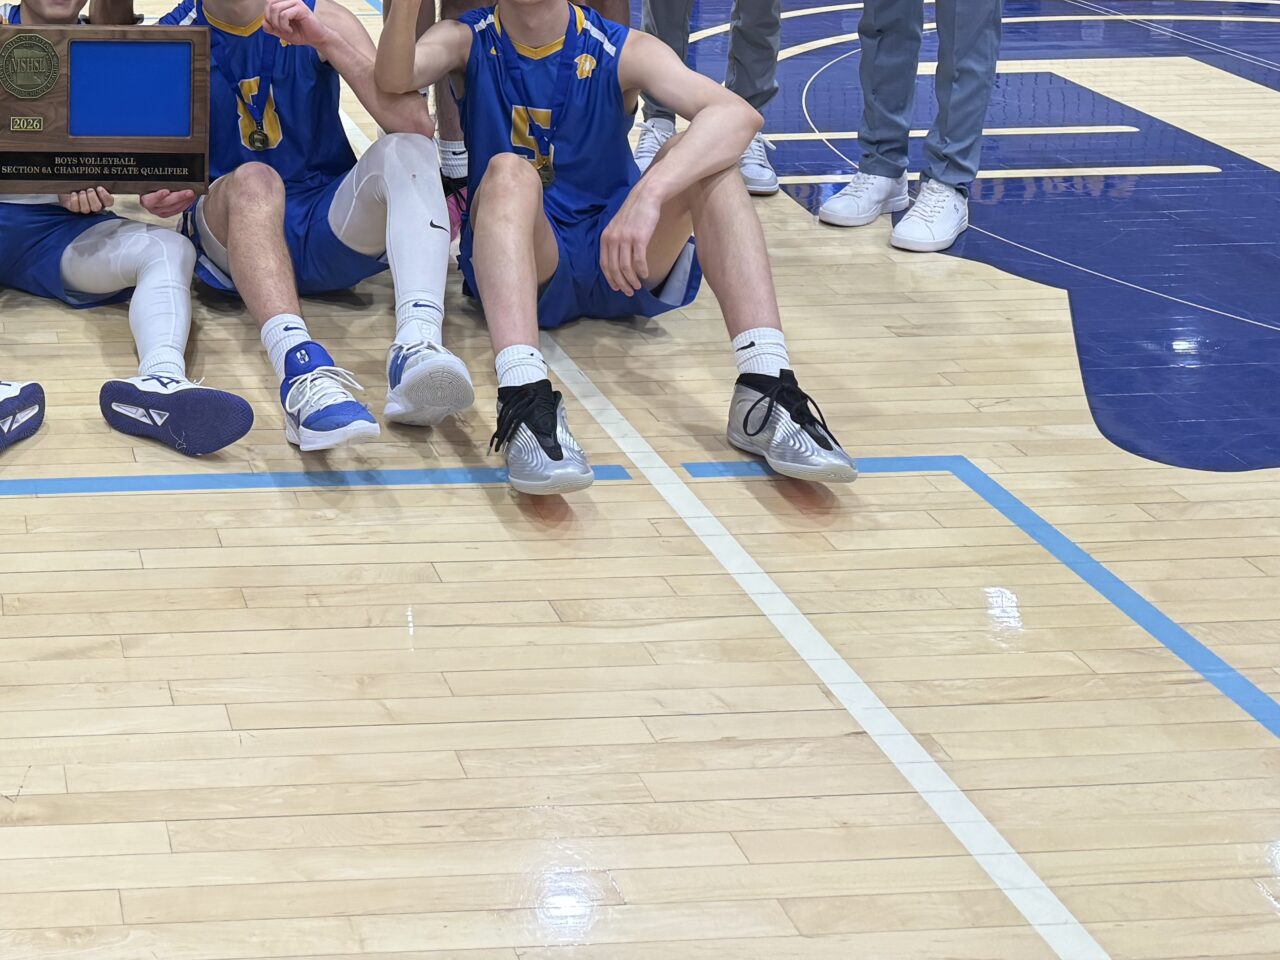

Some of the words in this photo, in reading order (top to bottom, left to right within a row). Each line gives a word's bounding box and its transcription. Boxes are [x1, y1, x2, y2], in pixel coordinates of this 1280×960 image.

[9, 58, 46, 73] MSHSL
[13, 118, 40, 129] 2026
[510, 104, 555, 170] 5
[54, 156, 78, 165] BOYS
[79, 157, 137, 166] VOLLEYBALL
[1, 165, 40, 174] SECTION
[54, 166, 101, 175] CHAMPION
[103, 167, 110, 175] &
[111, 167, 139, 175] STATE
[140, 167, 189, 176] QUALIFIER
